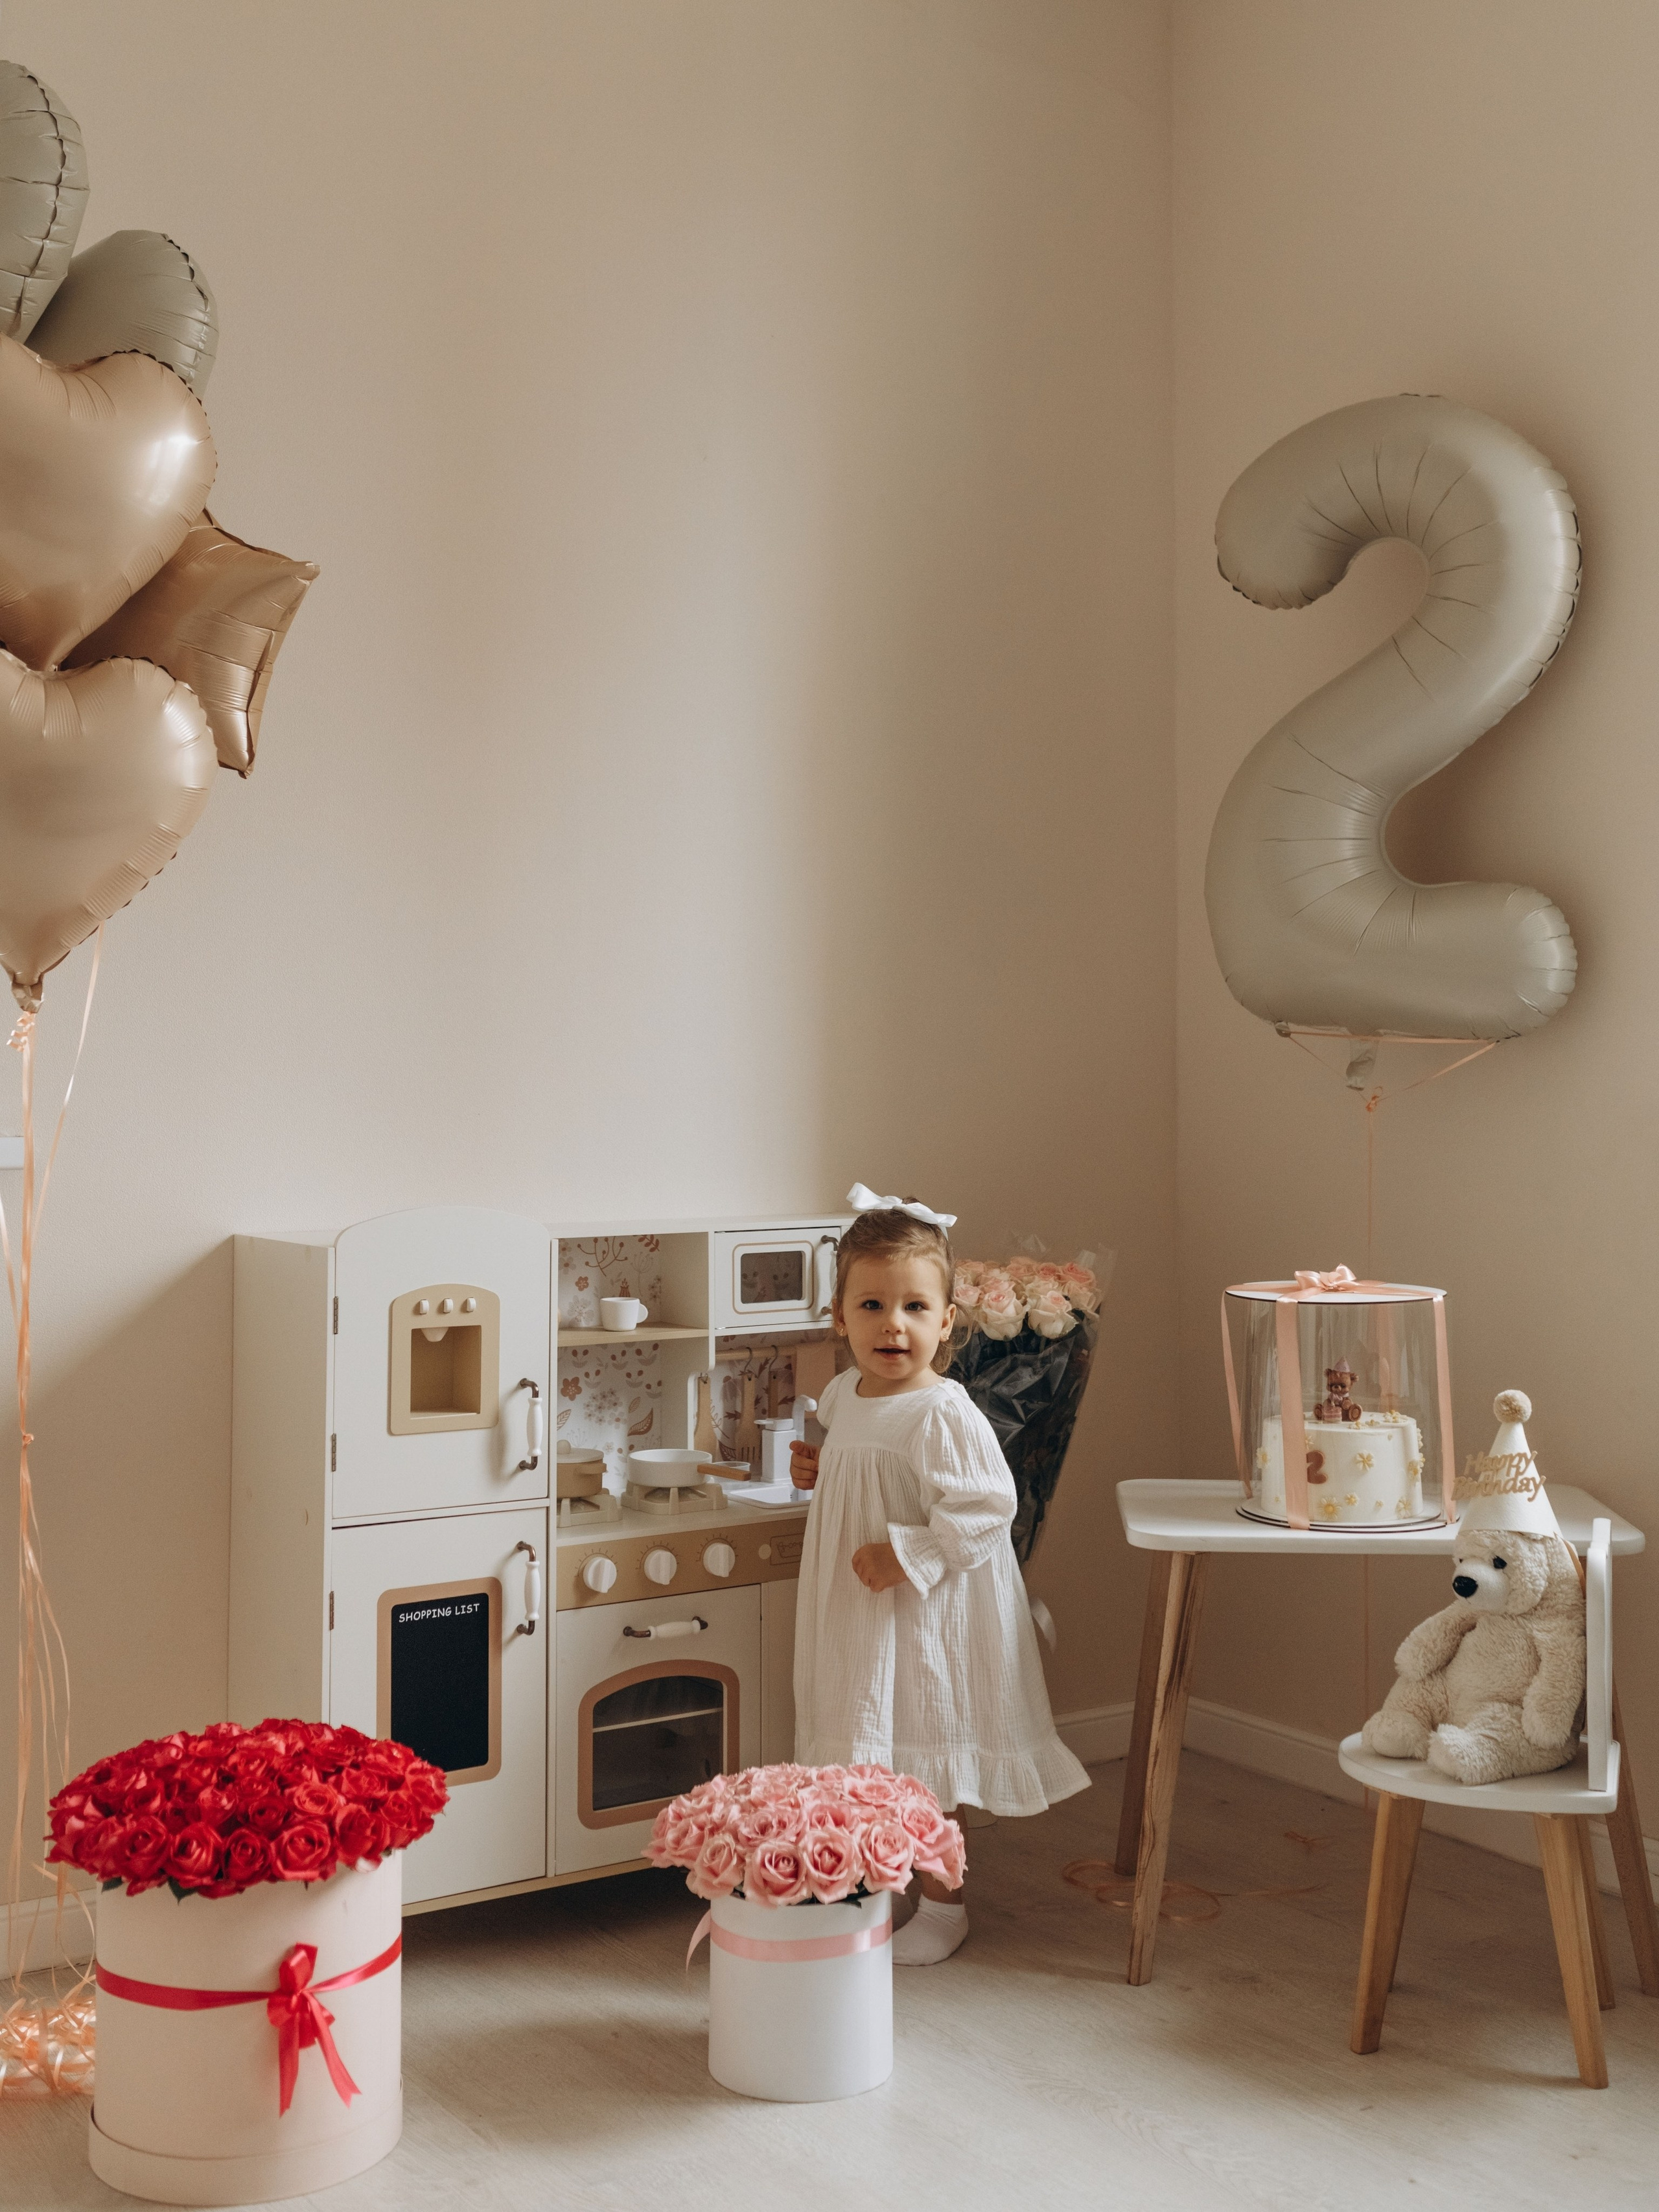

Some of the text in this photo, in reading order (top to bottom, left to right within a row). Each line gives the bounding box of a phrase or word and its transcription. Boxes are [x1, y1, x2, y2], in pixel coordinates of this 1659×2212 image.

[1204, 392, 1583, 1040] 2
[1306, 1449, 1328, 1484] 2
[1463, 1450, 1538, 1477] Happy
[399, 1603, 480, 1623] SHOPPING LIST
